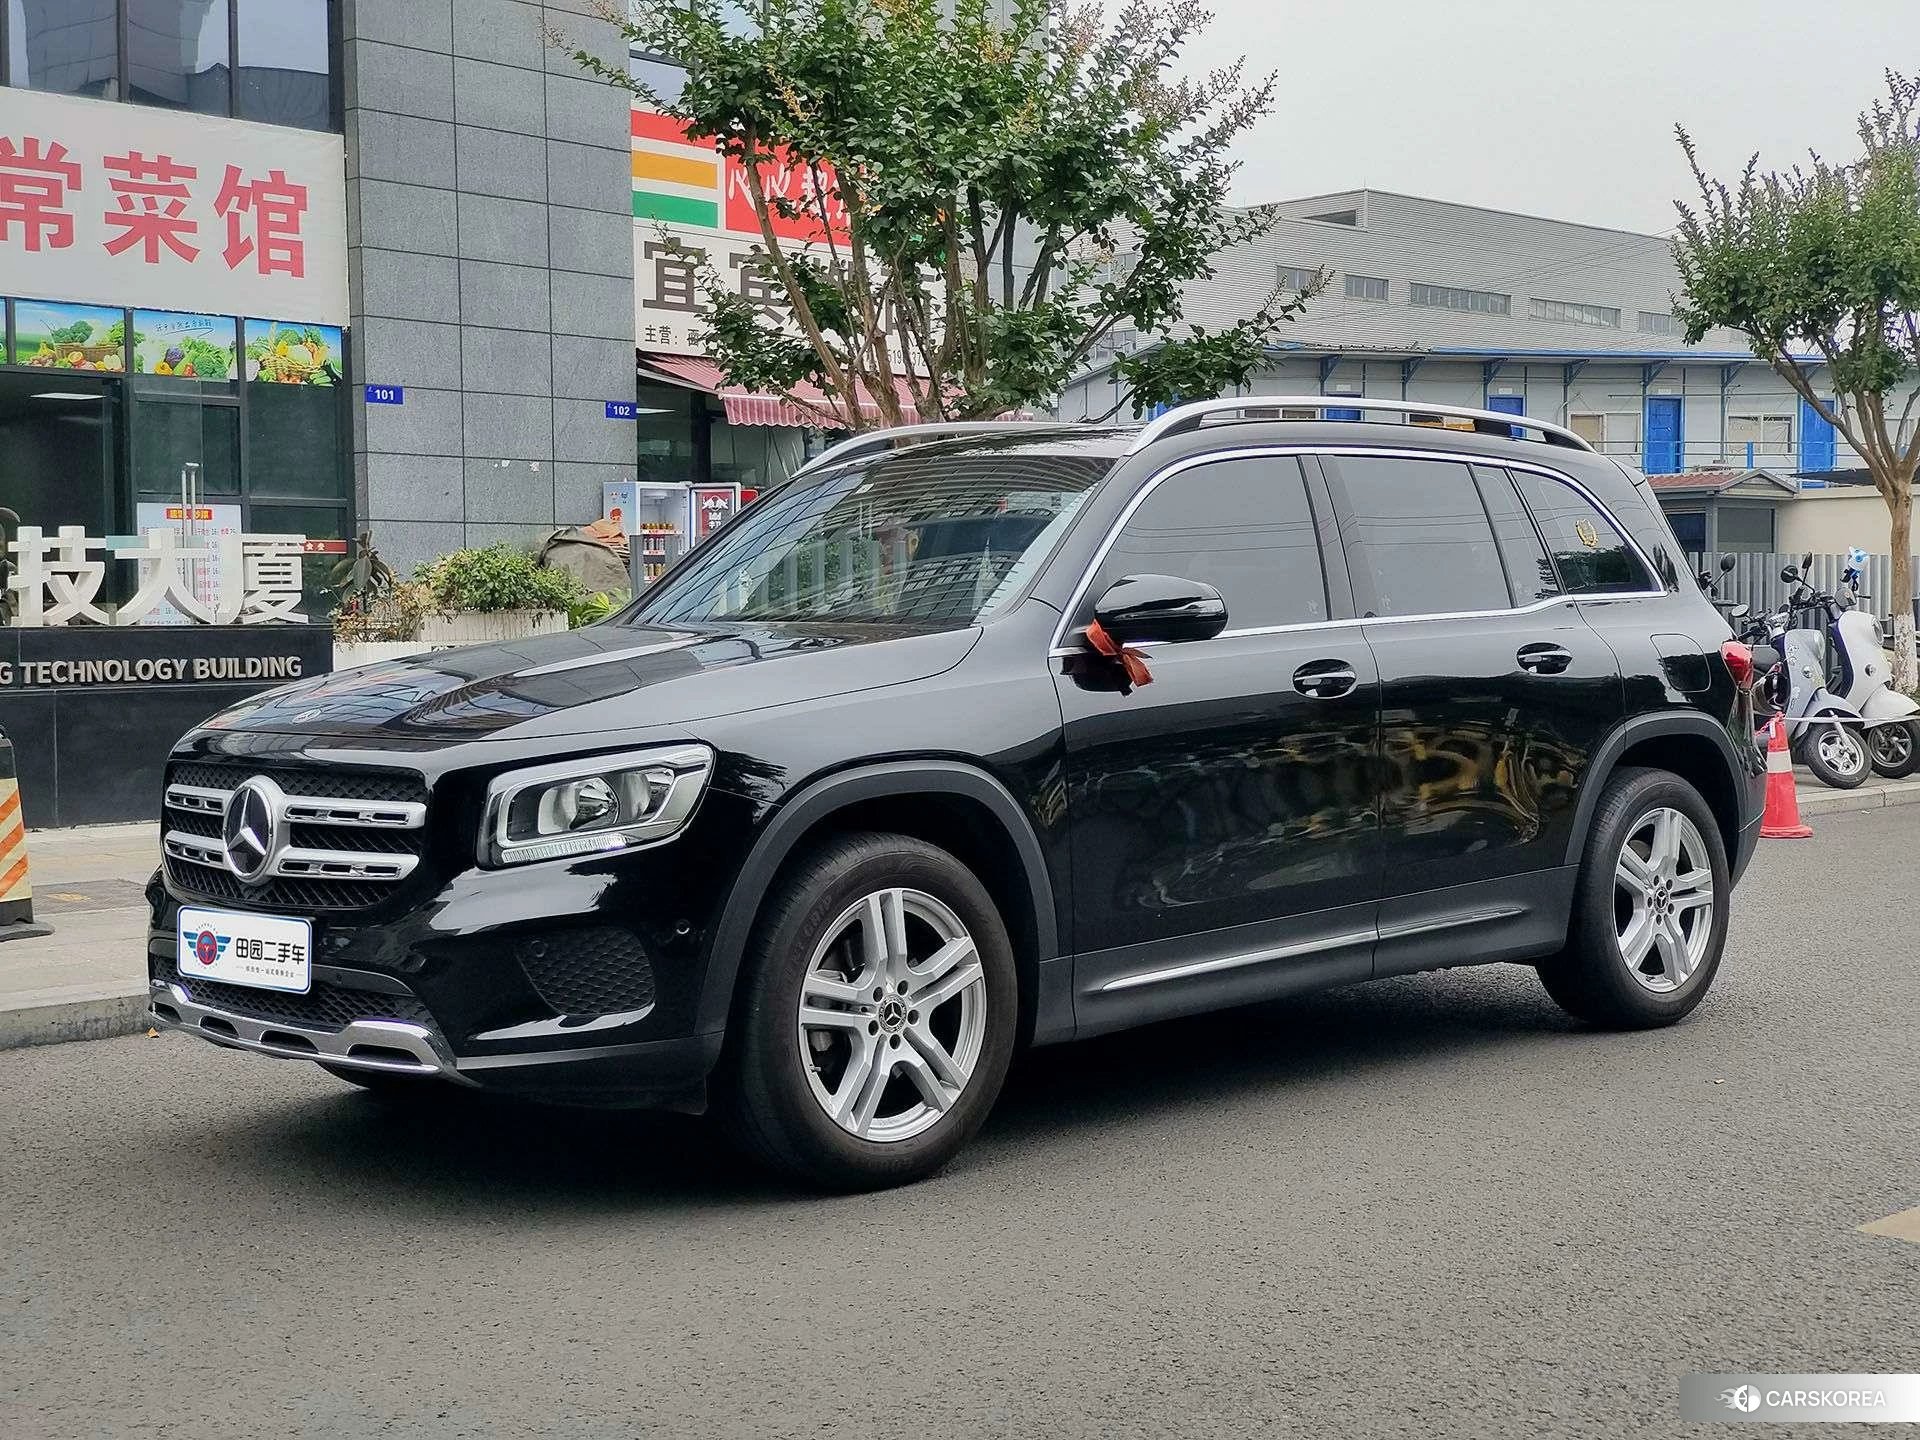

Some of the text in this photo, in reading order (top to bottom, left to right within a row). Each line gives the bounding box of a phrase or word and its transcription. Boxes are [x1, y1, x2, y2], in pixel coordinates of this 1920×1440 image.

[0, 136, 308, 278] 常菜馆
[374, 389, 394, 401] 101
[612, 404, 631, 416] 102
[8, 526, 309, 626] 技大厦
[18, 658, 188, 684] TECHNOLOGY
[192, 656, 302, 680] BUILDING
[236, 937, 305, 965] 田园二手车
